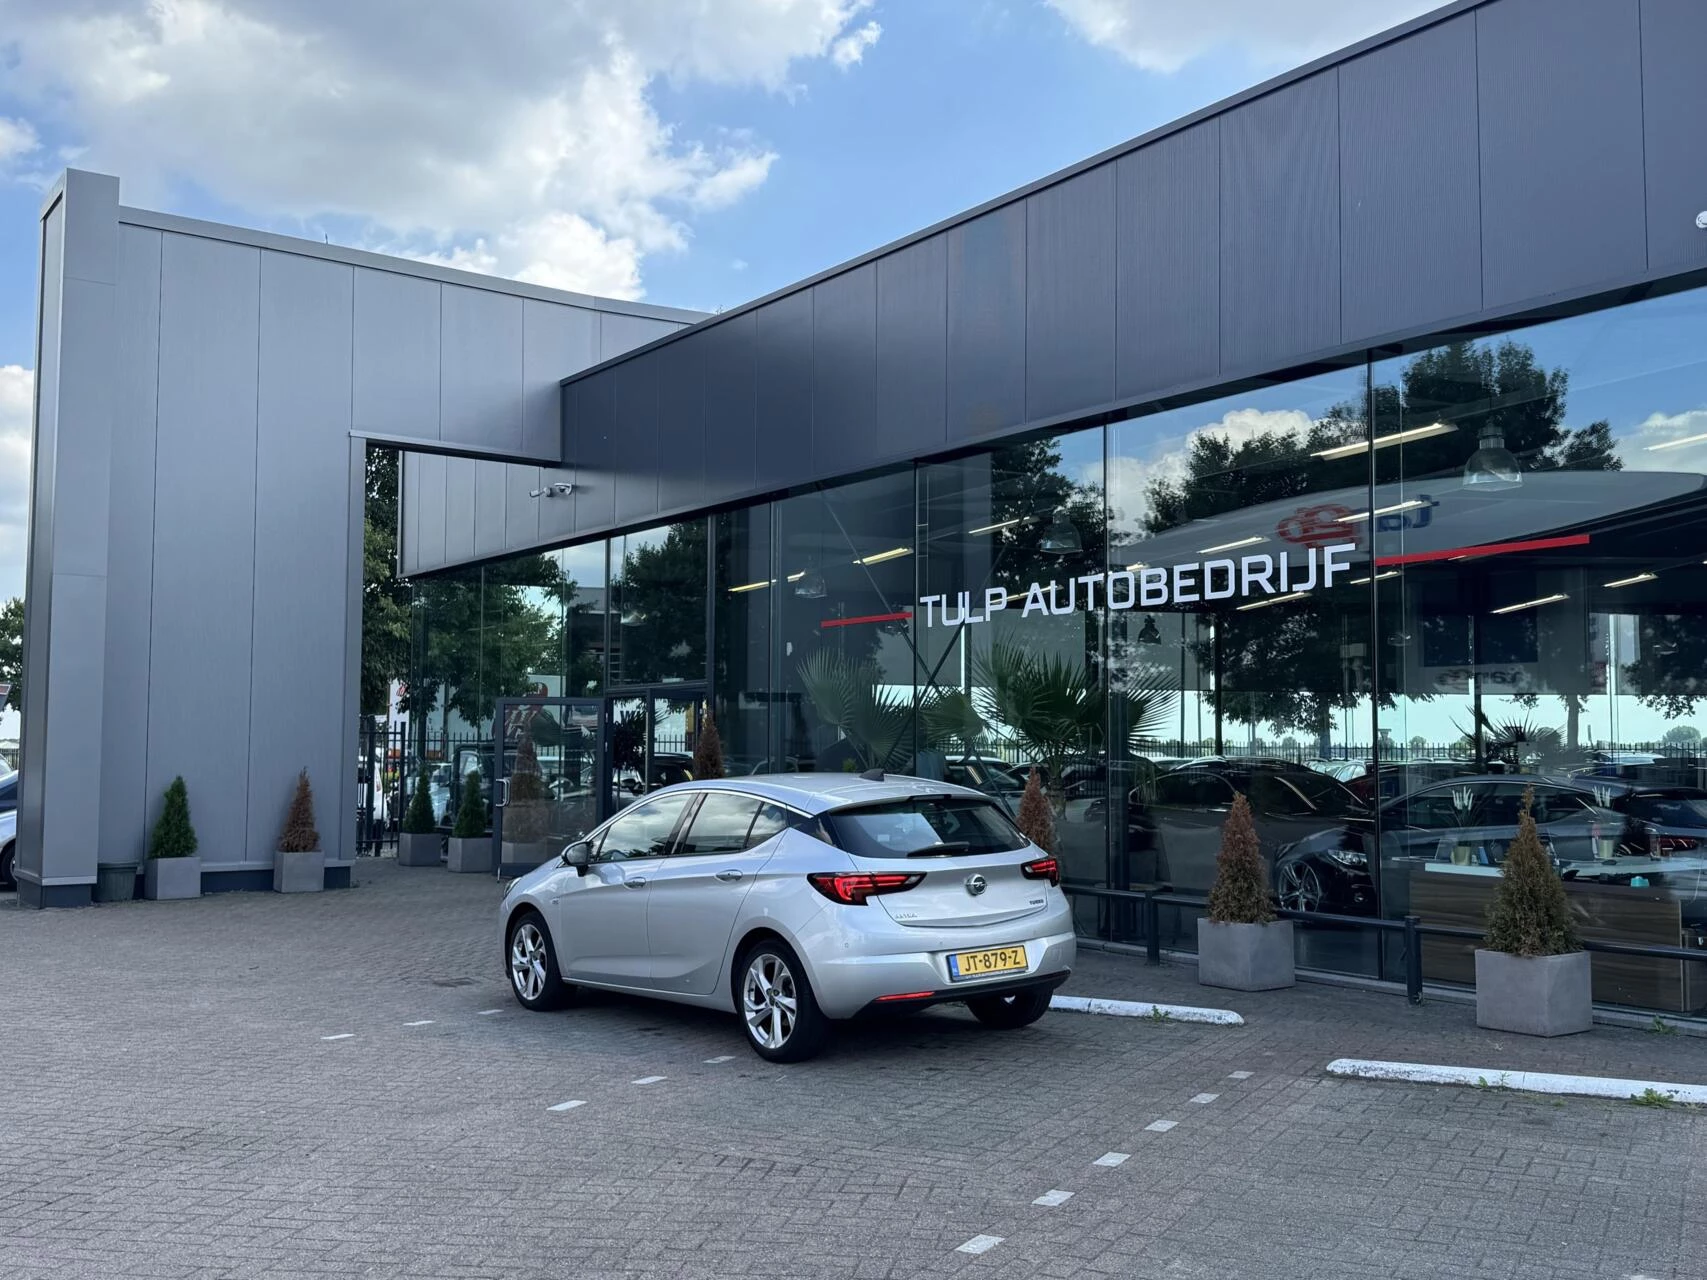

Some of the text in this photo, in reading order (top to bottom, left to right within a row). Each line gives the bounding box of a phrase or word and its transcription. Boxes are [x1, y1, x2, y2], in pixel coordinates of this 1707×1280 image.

[920, 543, 1356, 628] TULP AUTOBEDRIJF
[965, 950, 1020, 972] JT-879-Z
